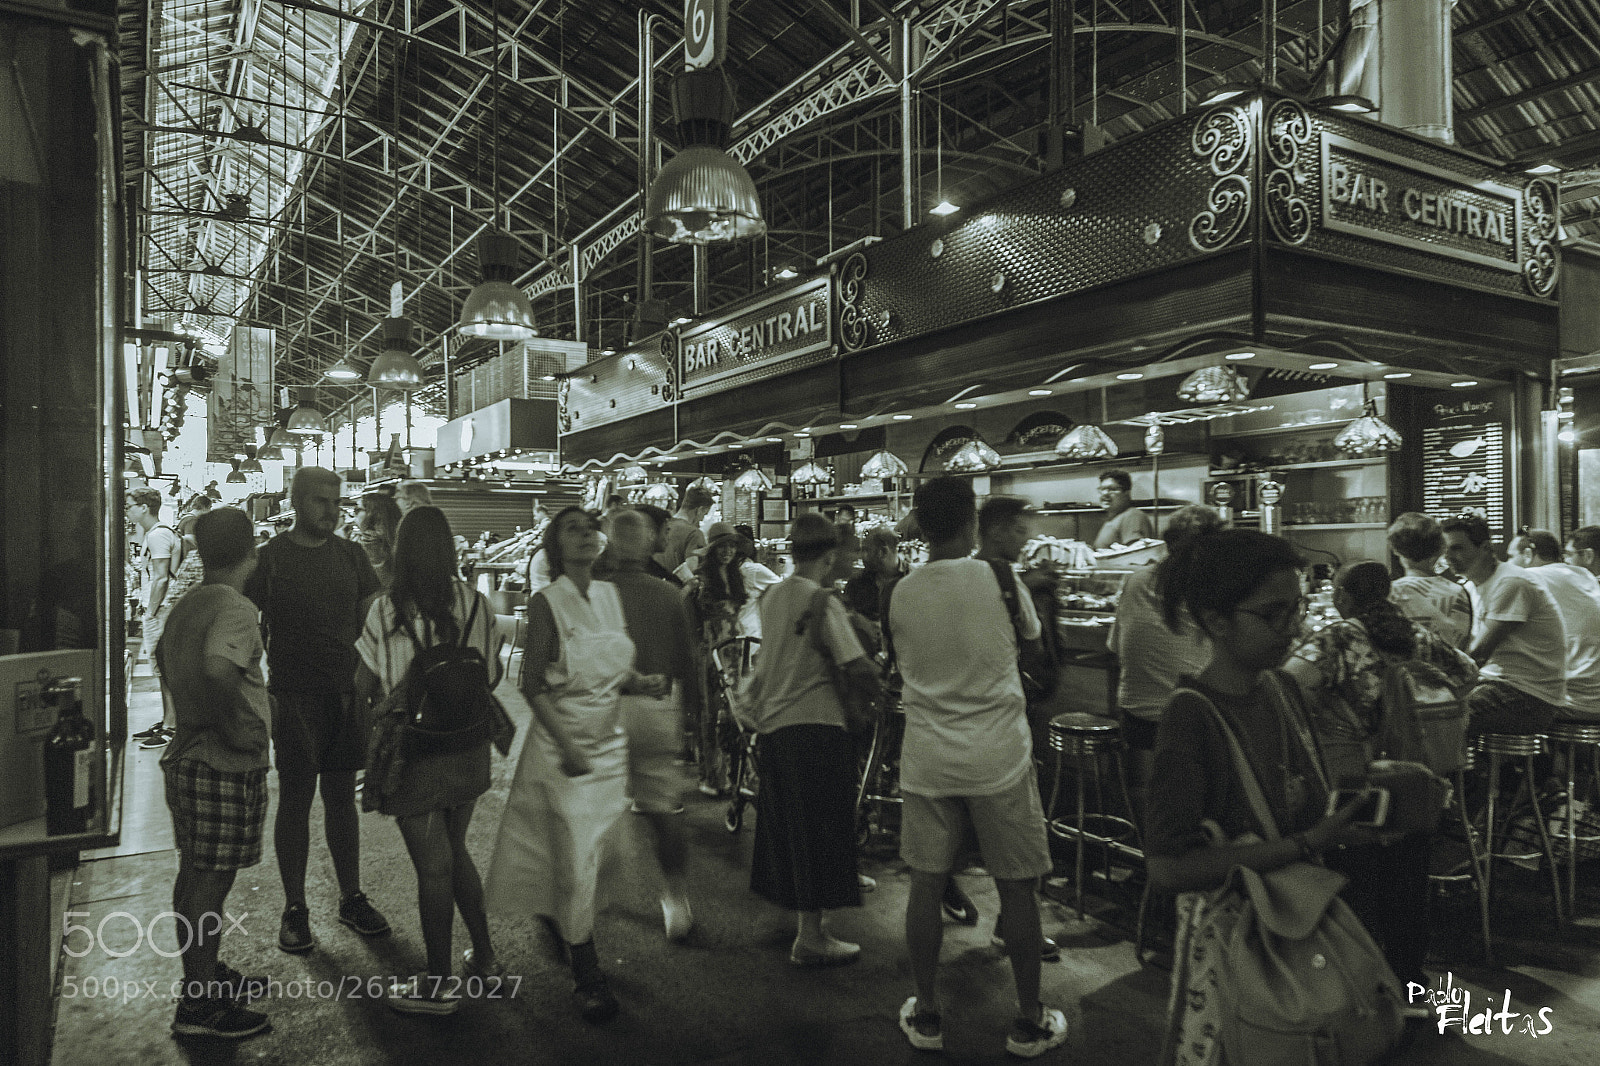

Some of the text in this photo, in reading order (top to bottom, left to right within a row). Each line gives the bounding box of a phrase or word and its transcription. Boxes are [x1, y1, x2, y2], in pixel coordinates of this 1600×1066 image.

[692, 0, 706, 44] 6
[1330, 162, 1514, 246] BAR CENTRAL
[685, 301, 823, 373] BAR CENTRAL
